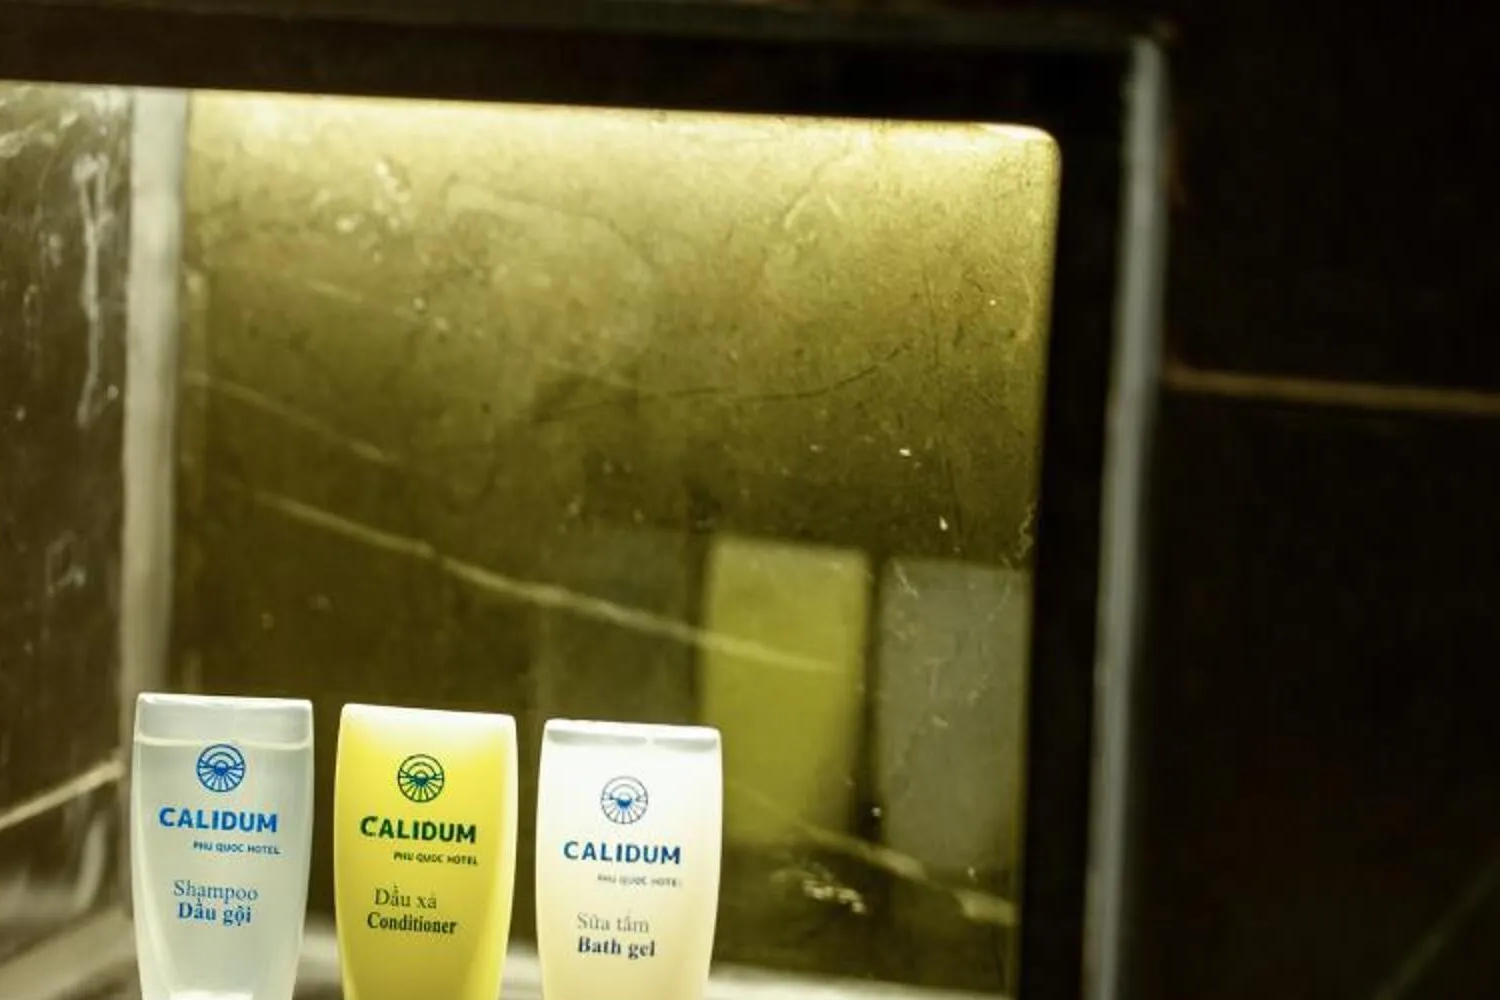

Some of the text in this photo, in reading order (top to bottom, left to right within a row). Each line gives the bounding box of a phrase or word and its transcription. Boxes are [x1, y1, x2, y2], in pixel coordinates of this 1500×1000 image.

[159, 806, 278, 833] CALIDUM
[360, 815, 477, 844] CALIDUM
[247, 844, 281, 855] HOTEL
[447, 855, 478, 865] HOTEL
[563, 840, 682, 865] CALIDUM
[173, 879, 259, 904] Shampoo
[223, 905, 252, 927] gội
[367, 911, 458, 935] Conditioner
[578, 936, 655, 960] Bath gel
